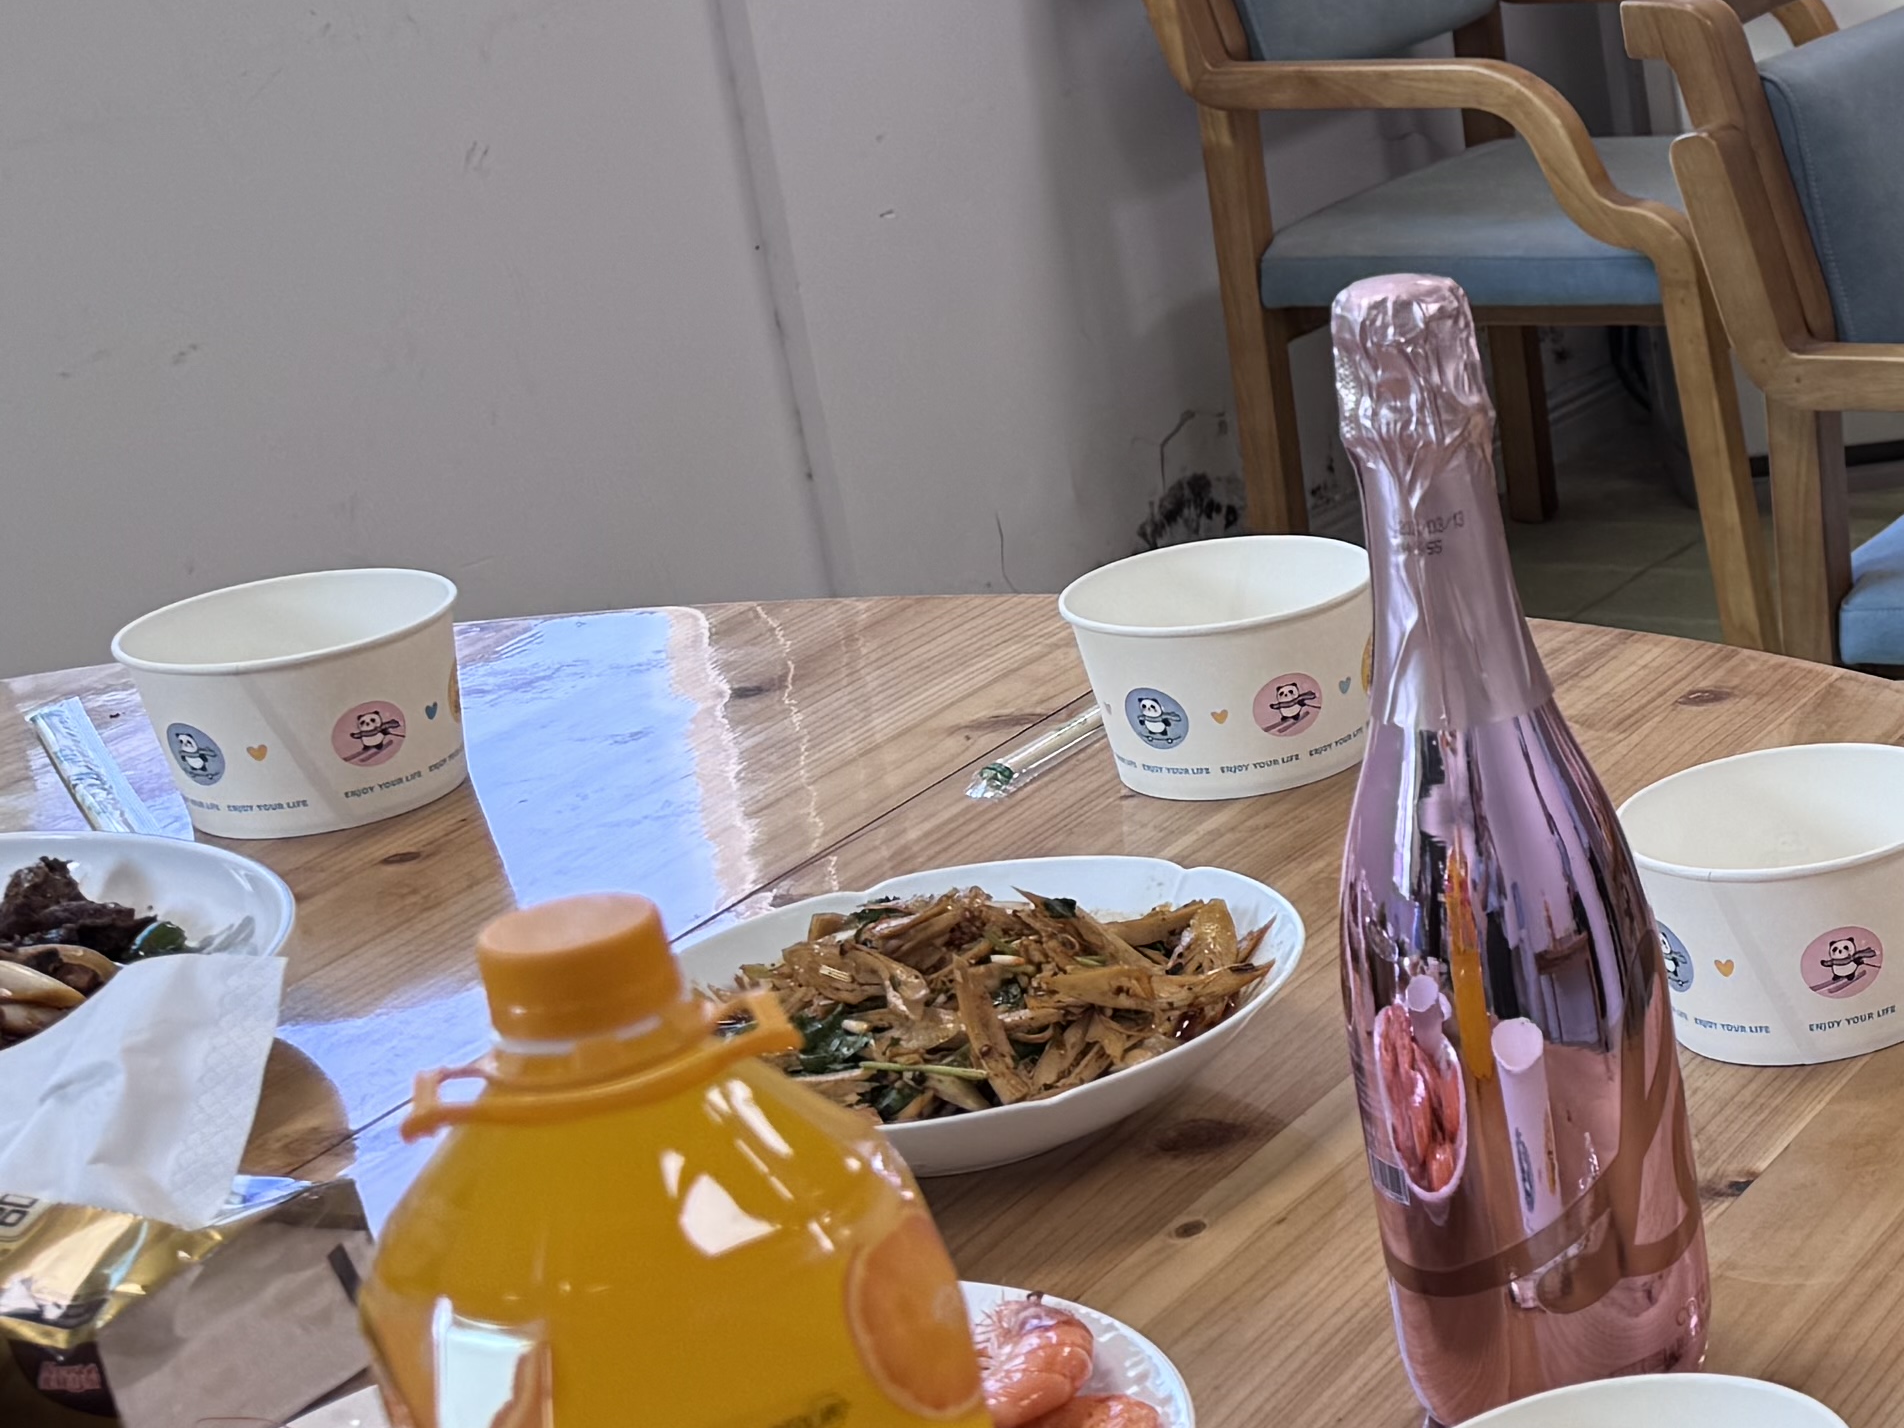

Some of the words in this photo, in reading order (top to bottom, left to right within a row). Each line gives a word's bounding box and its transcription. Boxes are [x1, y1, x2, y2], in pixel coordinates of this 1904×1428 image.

[1165, 767, 1190, 775] YOUR
[1220, 763, 1251, 774] ENJOY
[1252, 758, 1280, 770] YOUR
[1282, 754, 1300, 765] LIFE
[344, 785, 376, 799] ENJOY
[378, 777, 404, 790] YOUR
[405, 771, 424, 784] LIFE
[227, 804, 254, 814] ENJOY
[256, 802, 285, 812] YOUR
[286, 800, 309, 810] LIFE
[1694, 1017, 1718, 1031] ENJOY
[1720, 1023, 1748, 1033] YOUR
[1749, 1025, 1771, 1034] LIFE
[1808, 1019, 1842, 1032] ENJOY
[1845, 1011, 1875, 1025] YOUR
[1876, 1005, 1897, 1018] LIFE
